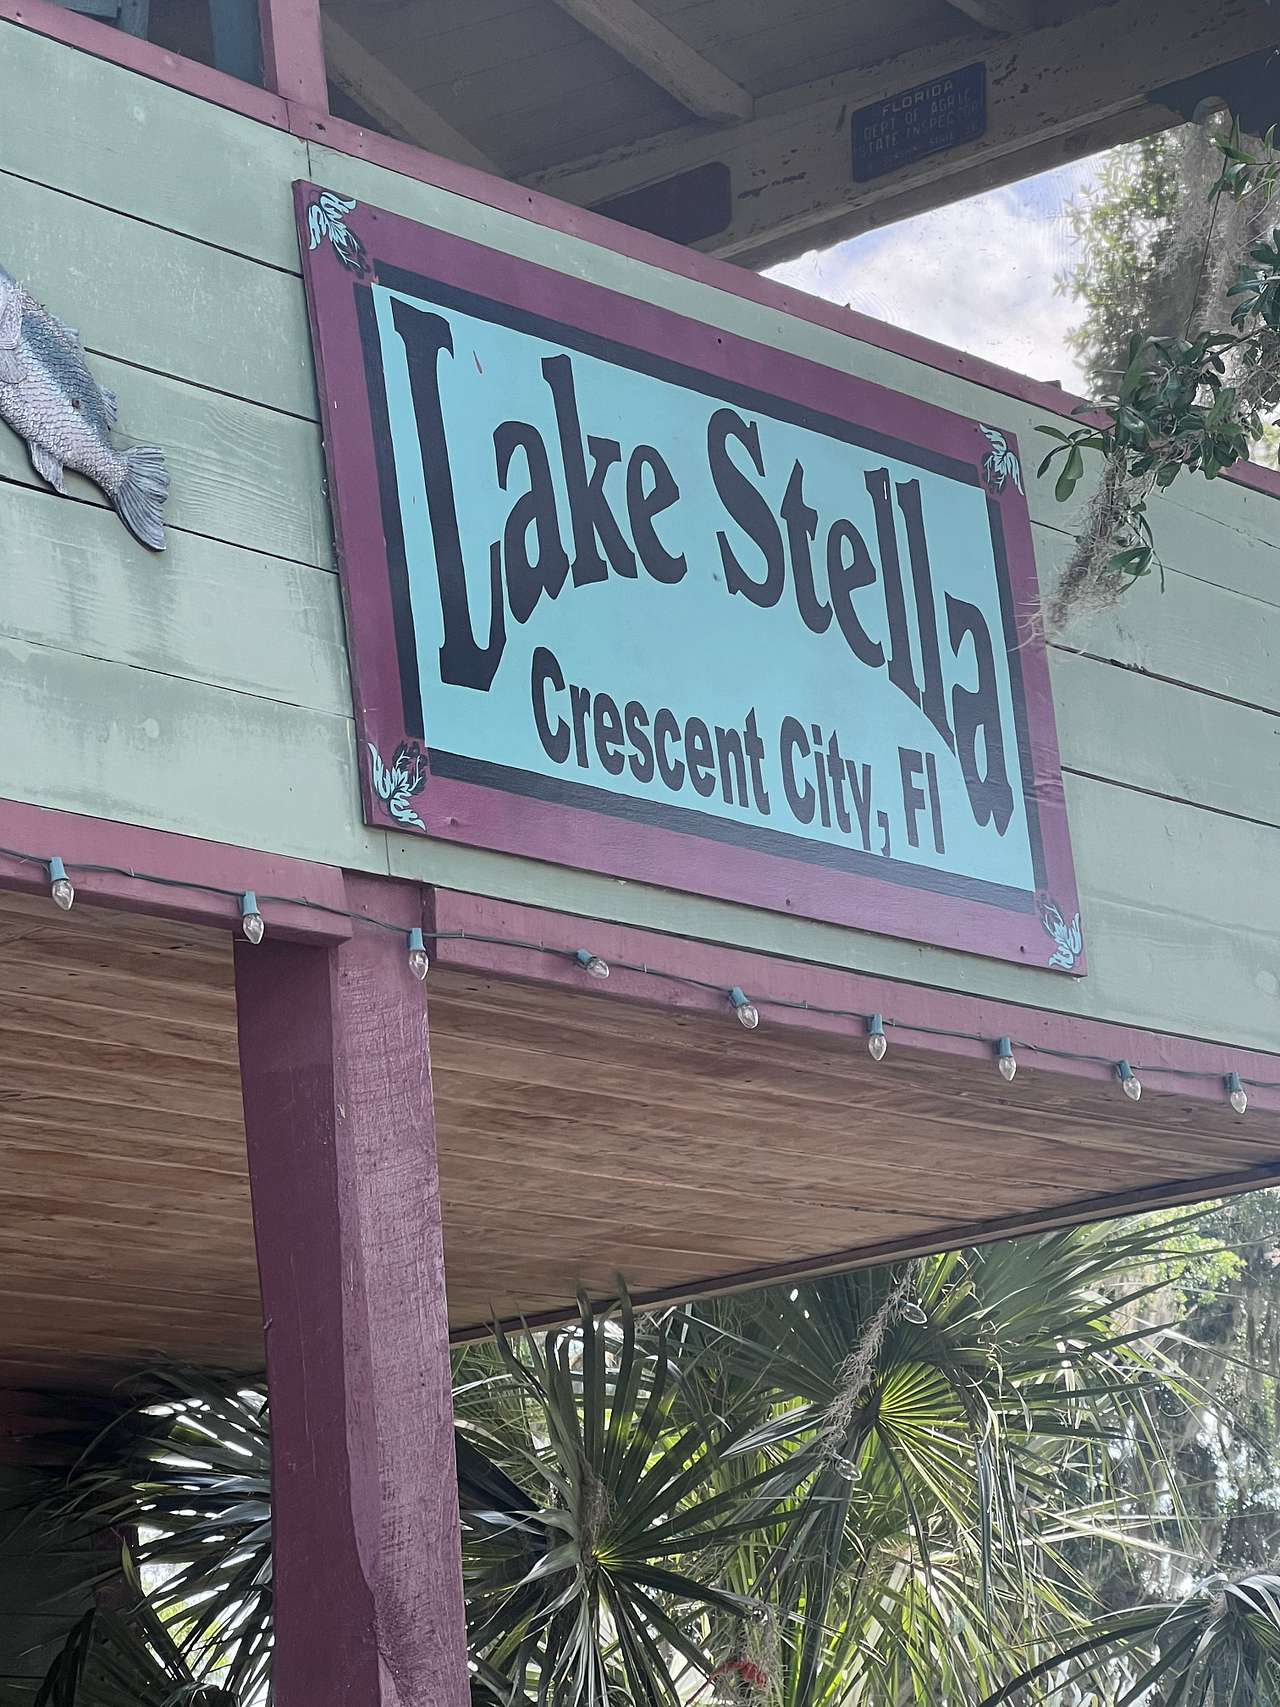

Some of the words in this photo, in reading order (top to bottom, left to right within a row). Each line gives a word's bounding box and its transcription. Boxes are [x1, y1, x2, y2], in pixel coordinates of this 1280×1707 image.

[882, 79, 953, 117] FLORIDA
[390, 295, 688, 692] Lake
[707, 408, 1014, 837] Stella
[531, 646, 770, 816] Crescent
[780, 715, 891, 858] City,
